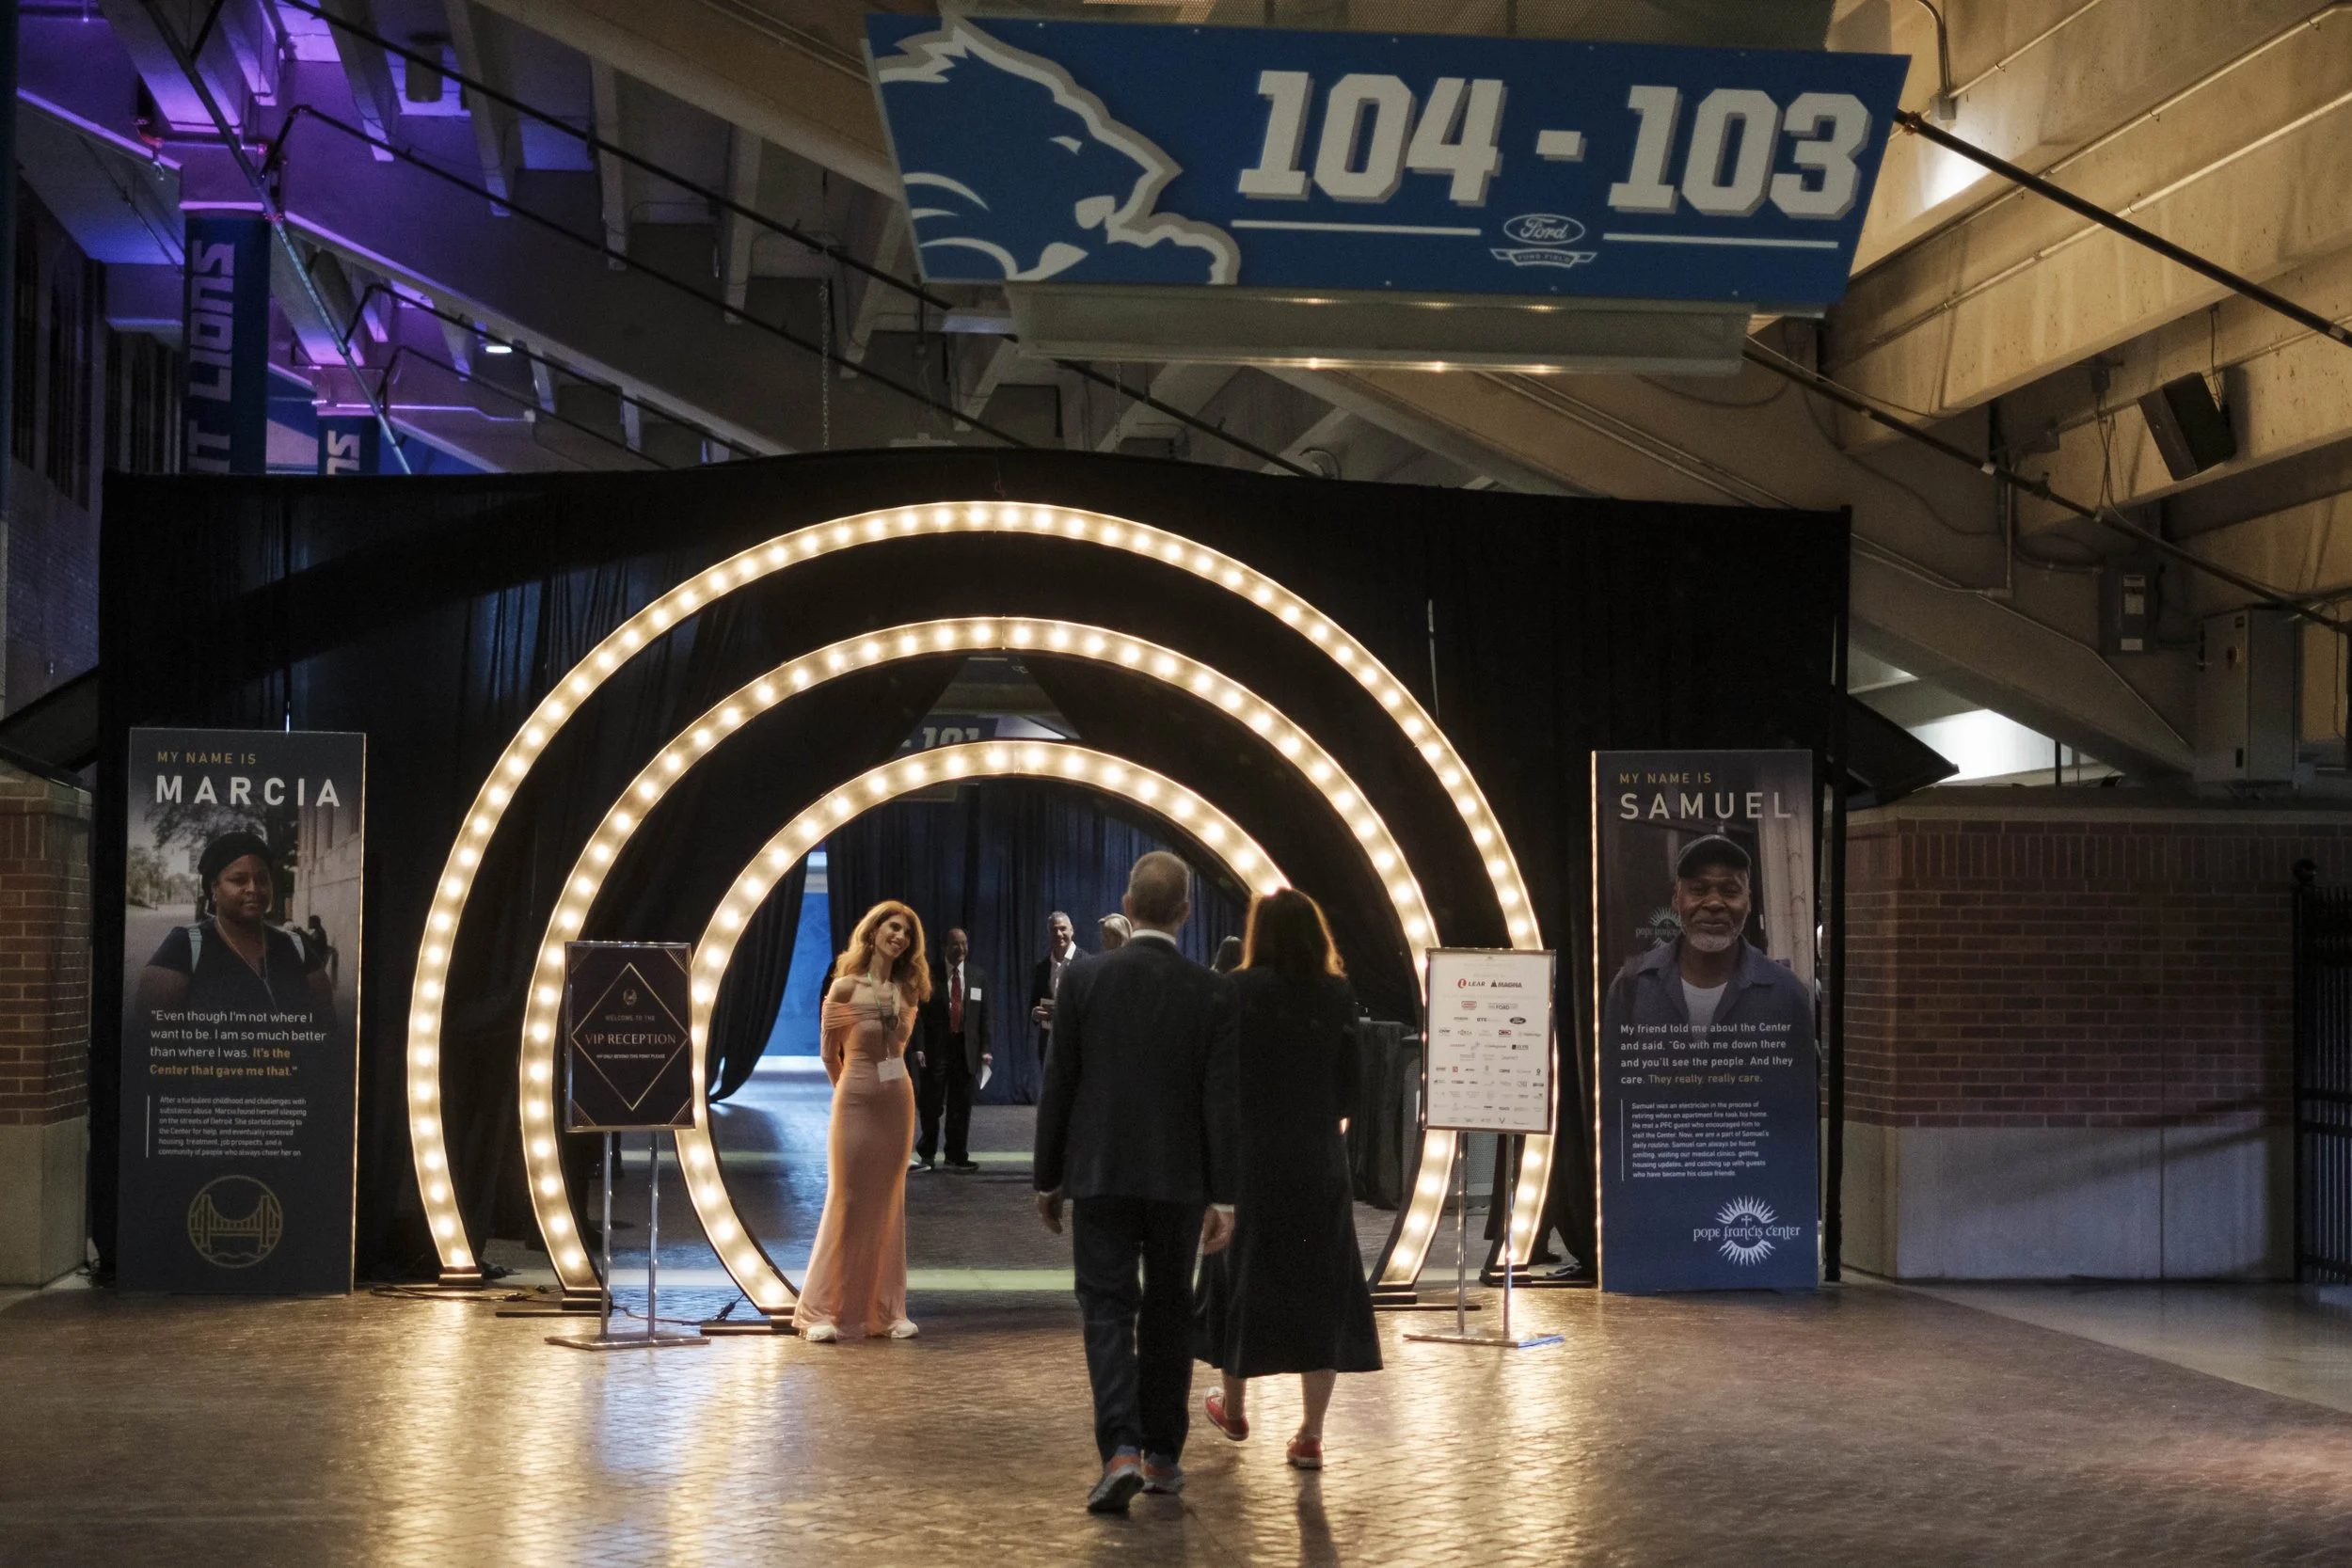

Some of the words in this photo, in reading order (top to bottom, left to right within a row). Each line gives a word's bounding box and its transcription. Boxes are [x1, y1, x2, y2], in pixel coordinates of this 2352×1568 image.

[1237, 71, 1502, 203] 104
[1608, 86, 1870, 216] 103
[1519, 217, 1568, 239] Ford
[190, 240, 234, 403] LIONS
[157, 752, 178, 763] MY
[186, 752, 233, 764] NAME
[241, 753, 257, 765] IS
[1619, 773, 1639, 783] MY
[1647, 772, 1691, 783] NAME
[1697, 772, 1711, 784] IS
[156, 775, 341, 807] MARCIA
[1620, 792, 1791, 819] SAMUEL
[187, 1010, 227, 1023] though
[230, 1010, 246, 1022] I'm
[248, 1010, 266, 1022] not
[270, 1011, 306, 1022] where
[150, 1028, 178, 1039] want
[182, 1029, 192, 1039] to
[220, 1032, 238, 1040] am
[241, 1032, 254, 1040] so
[256, 1030, 289, 1041] much
[292, 1031, 327, 1041] better
[1620, 1024, 1633, 1037] My
[1637, 1024, 1666, 1034] friend
[1670, 1024, 1688, 1033] told
[1708, 1023, 1737, 1033] about
[1740, 1023, 1756, 1032] the
[1758, 1022, 1791, 1032] Center
[585, 1034, 605, 1044] VIP
[608, 1034, 675, 1045] RECEPTION
[1620, 1041, 1639, 1050] and
[1689, 1040, 1708, 1049] with
[1731, 1039, 1757, 1049] down
[1760, 1039, 1787, 1048] there
[150, 1046, 175, 1056] than
[178, 1046, 215, 1057] where
[252, 1047, 269, 1058] It's
[272, 1048, 291, 1058] the
[1620, 1058, 1639, 1068] and
[1642, 1058, 1668, 1069] you'll
[1692, 1057, 1707, 1067] the
[1750, 1056, 1769, 1066] And
[1772, 1056, 1793, 1068] they
[149, 1064, 187, 1074] Center
[191, 1065, 213, 1075] that
[216, 1068, 243, 1078] gave
[246, 1068, 263, 1076] me
[1649, 1075, 1671, 1086] They
[1708, 1073, 1735, 1085] really
[1693, 1227, 1721, 1241] pope
[1724, 1226, 1763, 1241] francis
[1766, 1226, 1800, 1240] center
